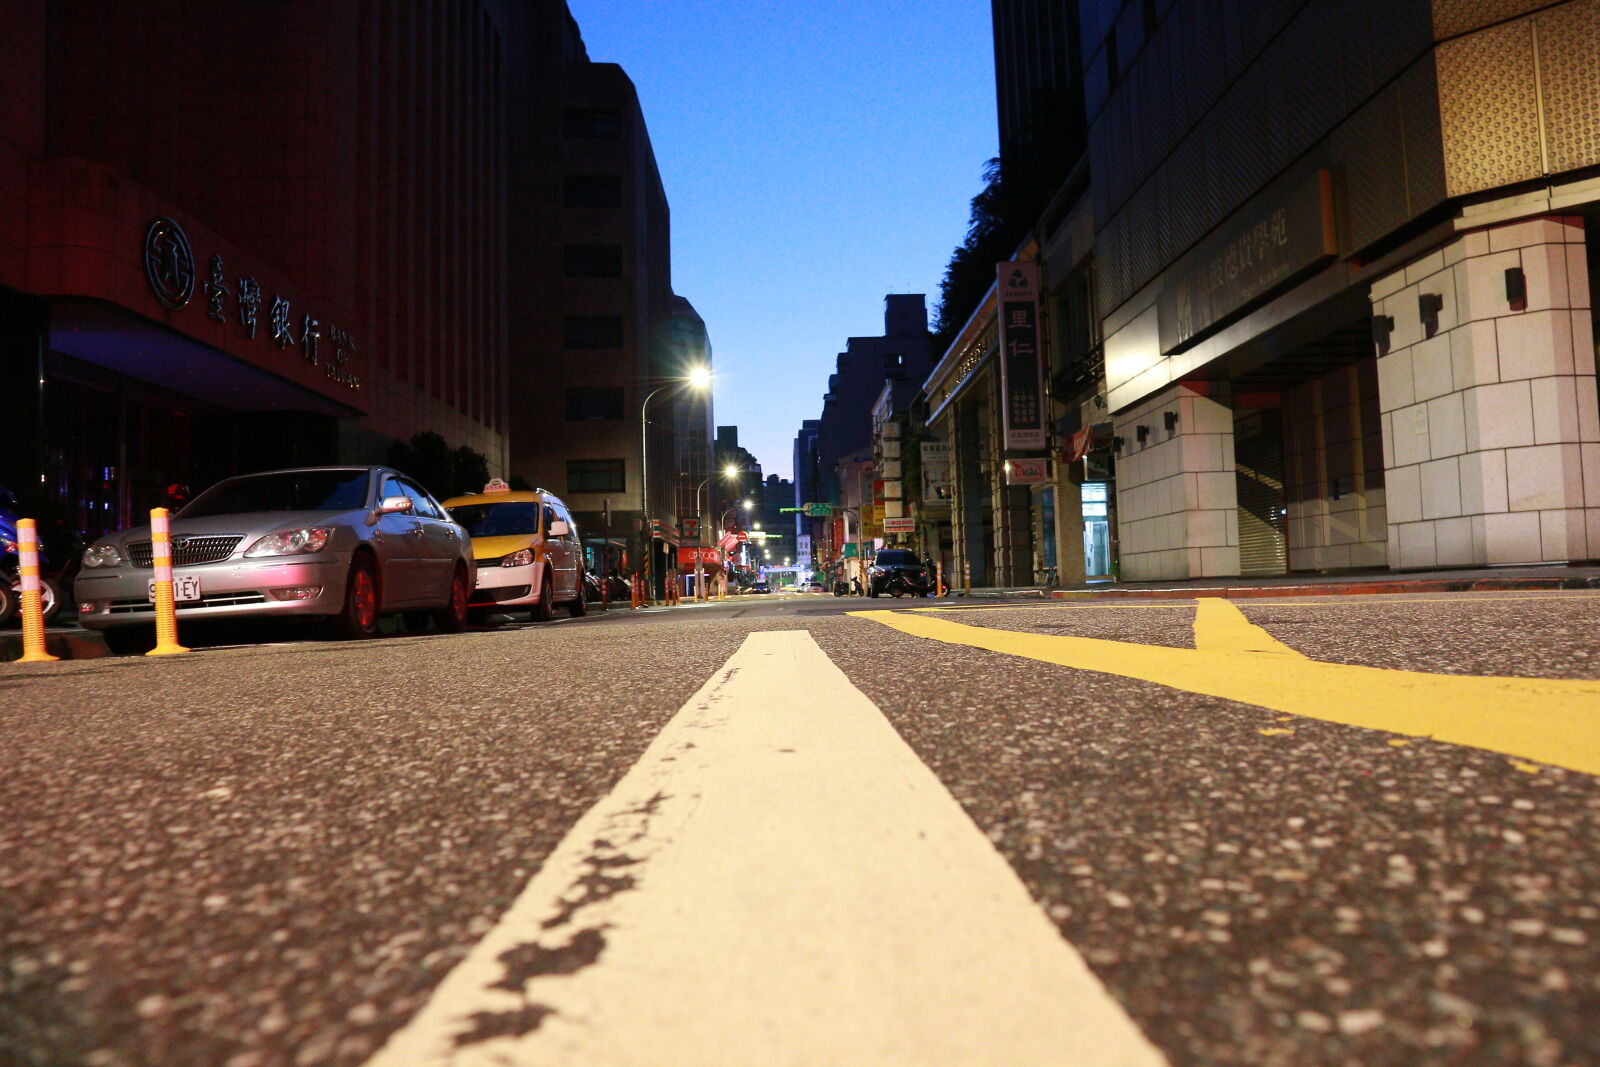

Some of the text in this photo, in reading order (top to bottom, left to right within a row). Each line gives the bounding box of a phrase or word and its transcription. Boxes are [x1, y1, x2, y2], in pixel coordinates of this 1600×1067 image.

[201, 254, 321, 366] 臺灣銀行
[330, 324, 357, 351] BANK
[1007, 310, 1034, 357] 里仁
[324, 361, 361, 391] TAIWAN
